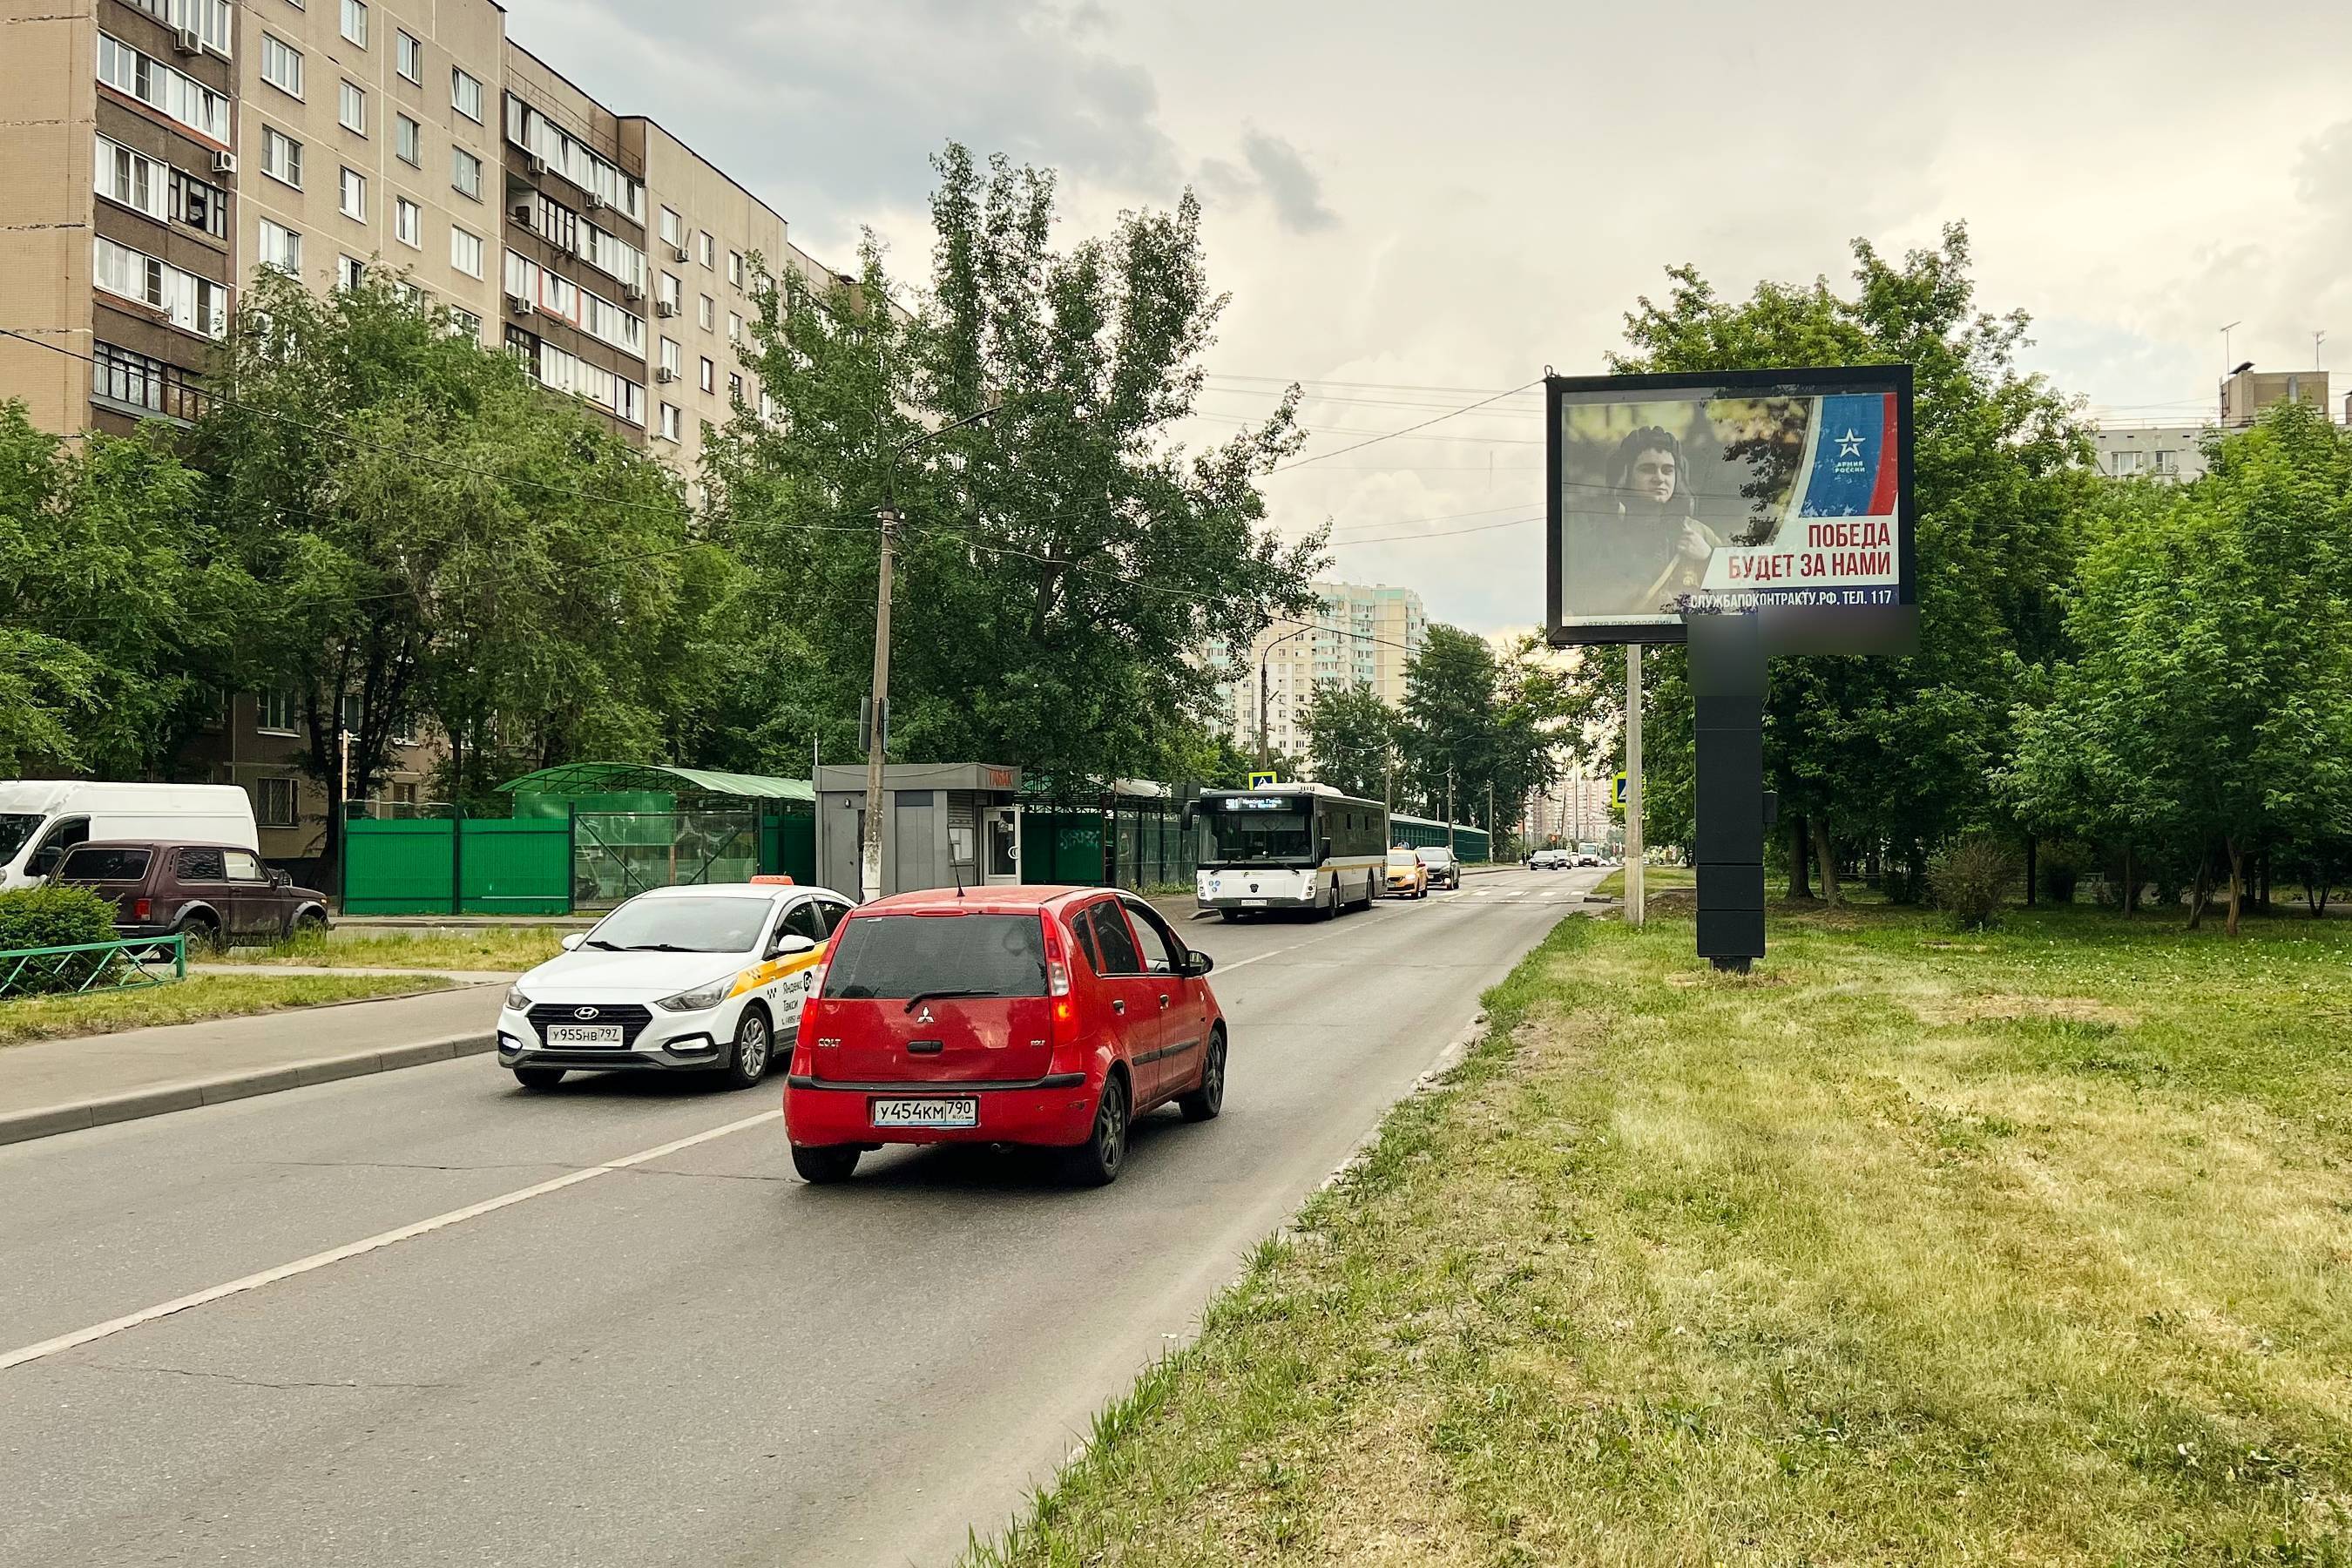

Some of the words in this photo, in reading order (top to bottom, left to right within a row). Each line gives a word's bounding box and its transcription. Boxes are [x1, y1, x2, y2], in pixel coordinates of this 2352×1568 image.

[1808, 523, 1891, 549] ПОБЕДА
[1728, 554, 1794, 581] БУДЕТ
[1800, 553, 1826, 577] ЗА
[1832, 551, 1891, 576] НАМИ
[1842, 591, 1868, 605] ТЕЛ.
[1871, 590, 1892, 605] 117
[783, 981, 802, 994] Яндекс
[783, 999, 799, 1011] Такси
[553, 1029, 598, 1041] У955НВ
[599, 1029, 618, 1037] 797
[818, 1037, 841, 1047] COLT
[880, 1103, 944, 1119] У454КМ
[947, 1101, 971, 1114] 790
